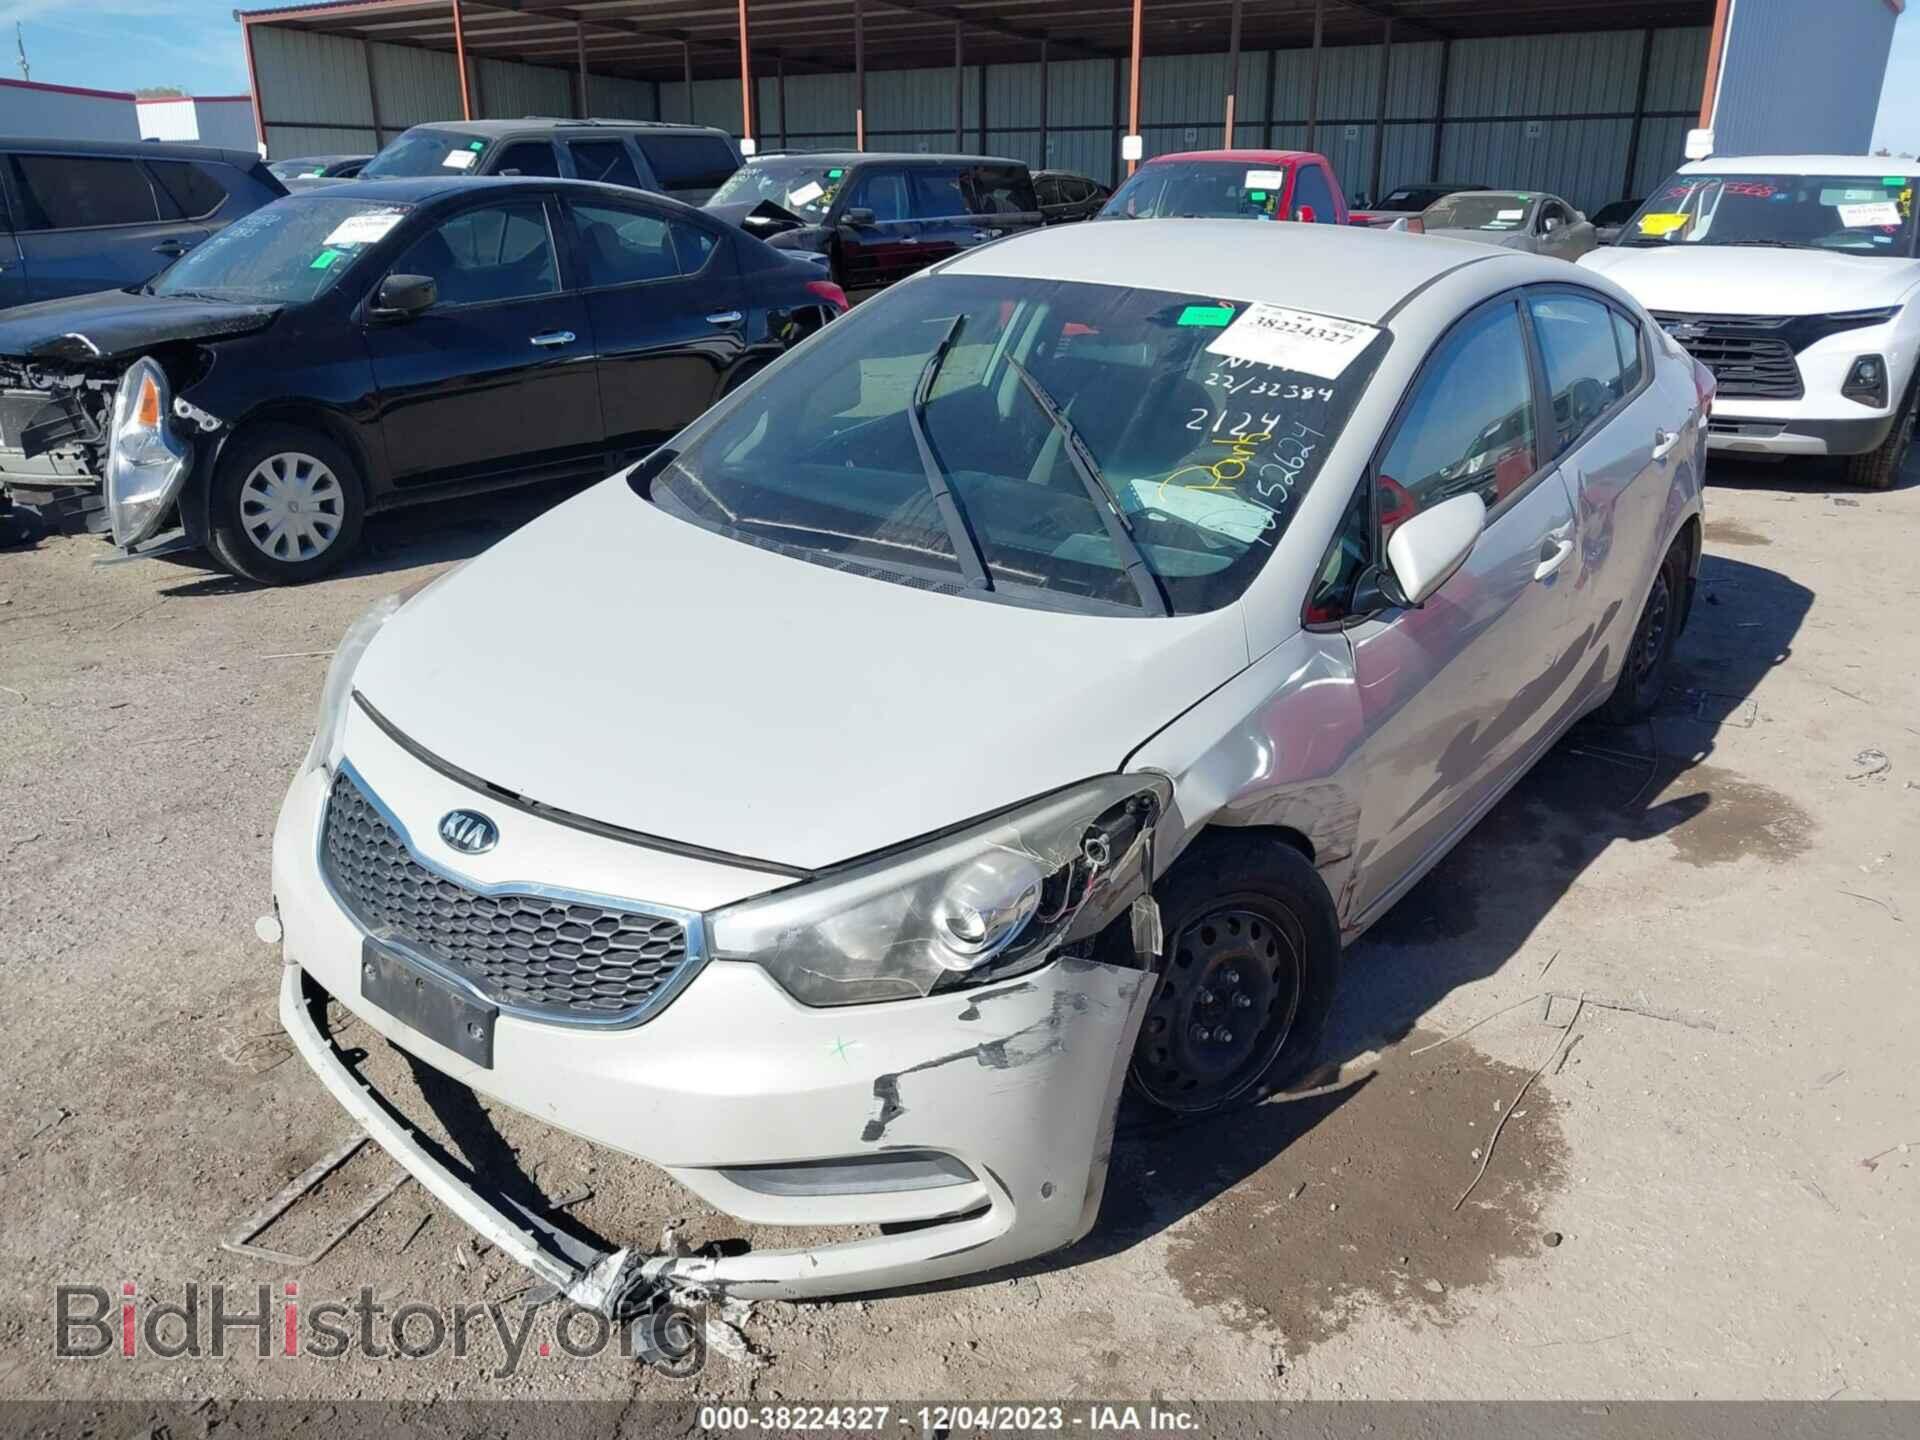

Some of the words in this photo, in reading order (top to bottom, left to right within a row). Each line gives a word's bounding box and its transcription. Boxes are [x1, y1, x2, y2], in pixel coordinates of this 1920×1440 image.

[1257, 315, 1354, 344] 38224327
[1186, 407, 1280, 436] 2124
[443, 812, 487, 848] KIA
